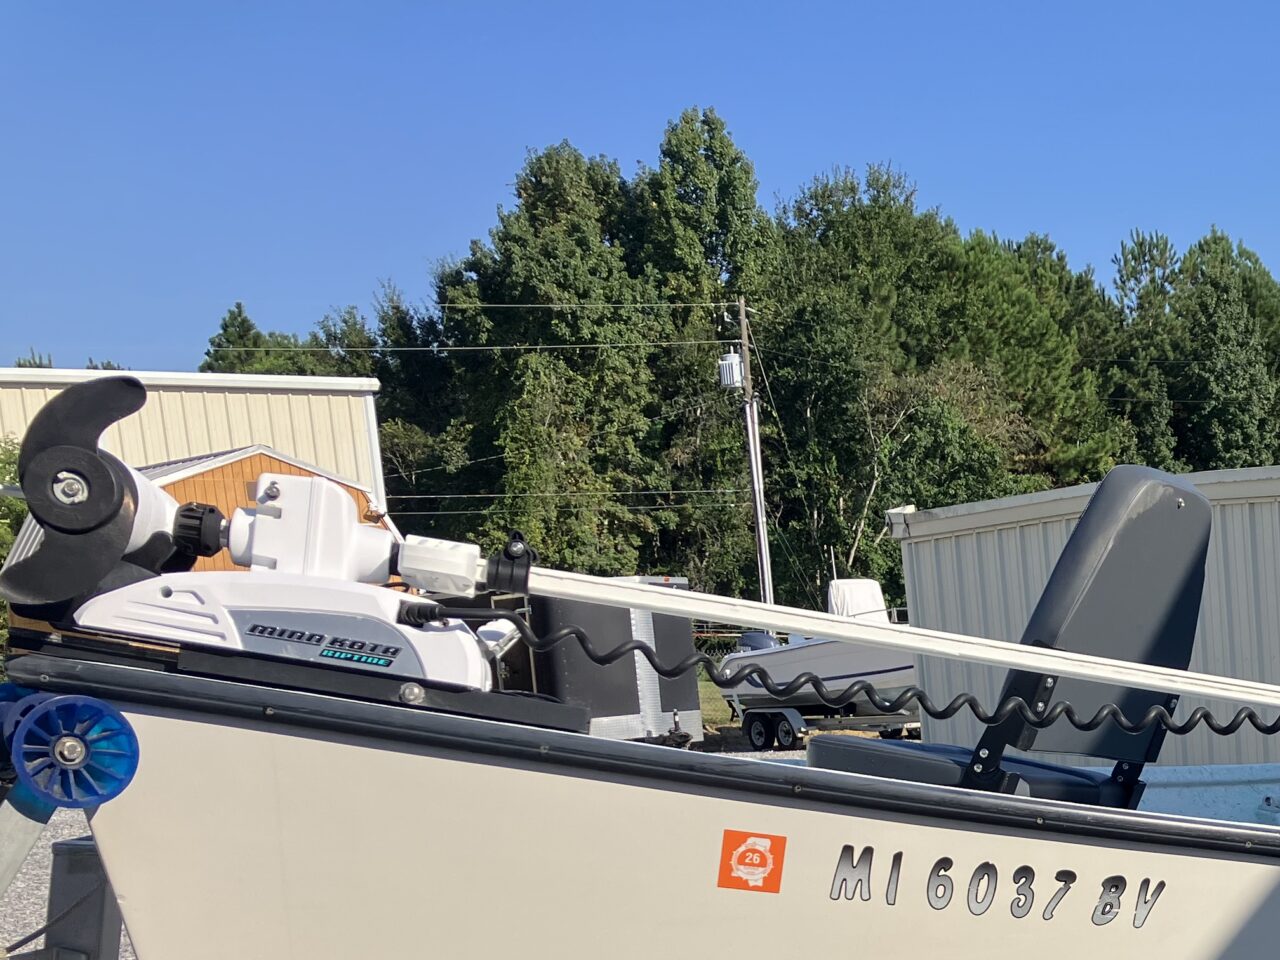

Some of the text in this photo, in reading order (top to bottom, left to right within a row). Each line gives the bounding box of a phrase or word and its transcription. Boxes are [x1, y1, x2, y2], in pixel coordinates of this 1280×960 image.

[325, 635, 403, 658] KOTA
[321, 648, 391, 667] RIPTIDE
[744, 852, 761, 864] 26
[830, 844, 1166, 929] MI 6037 BV
